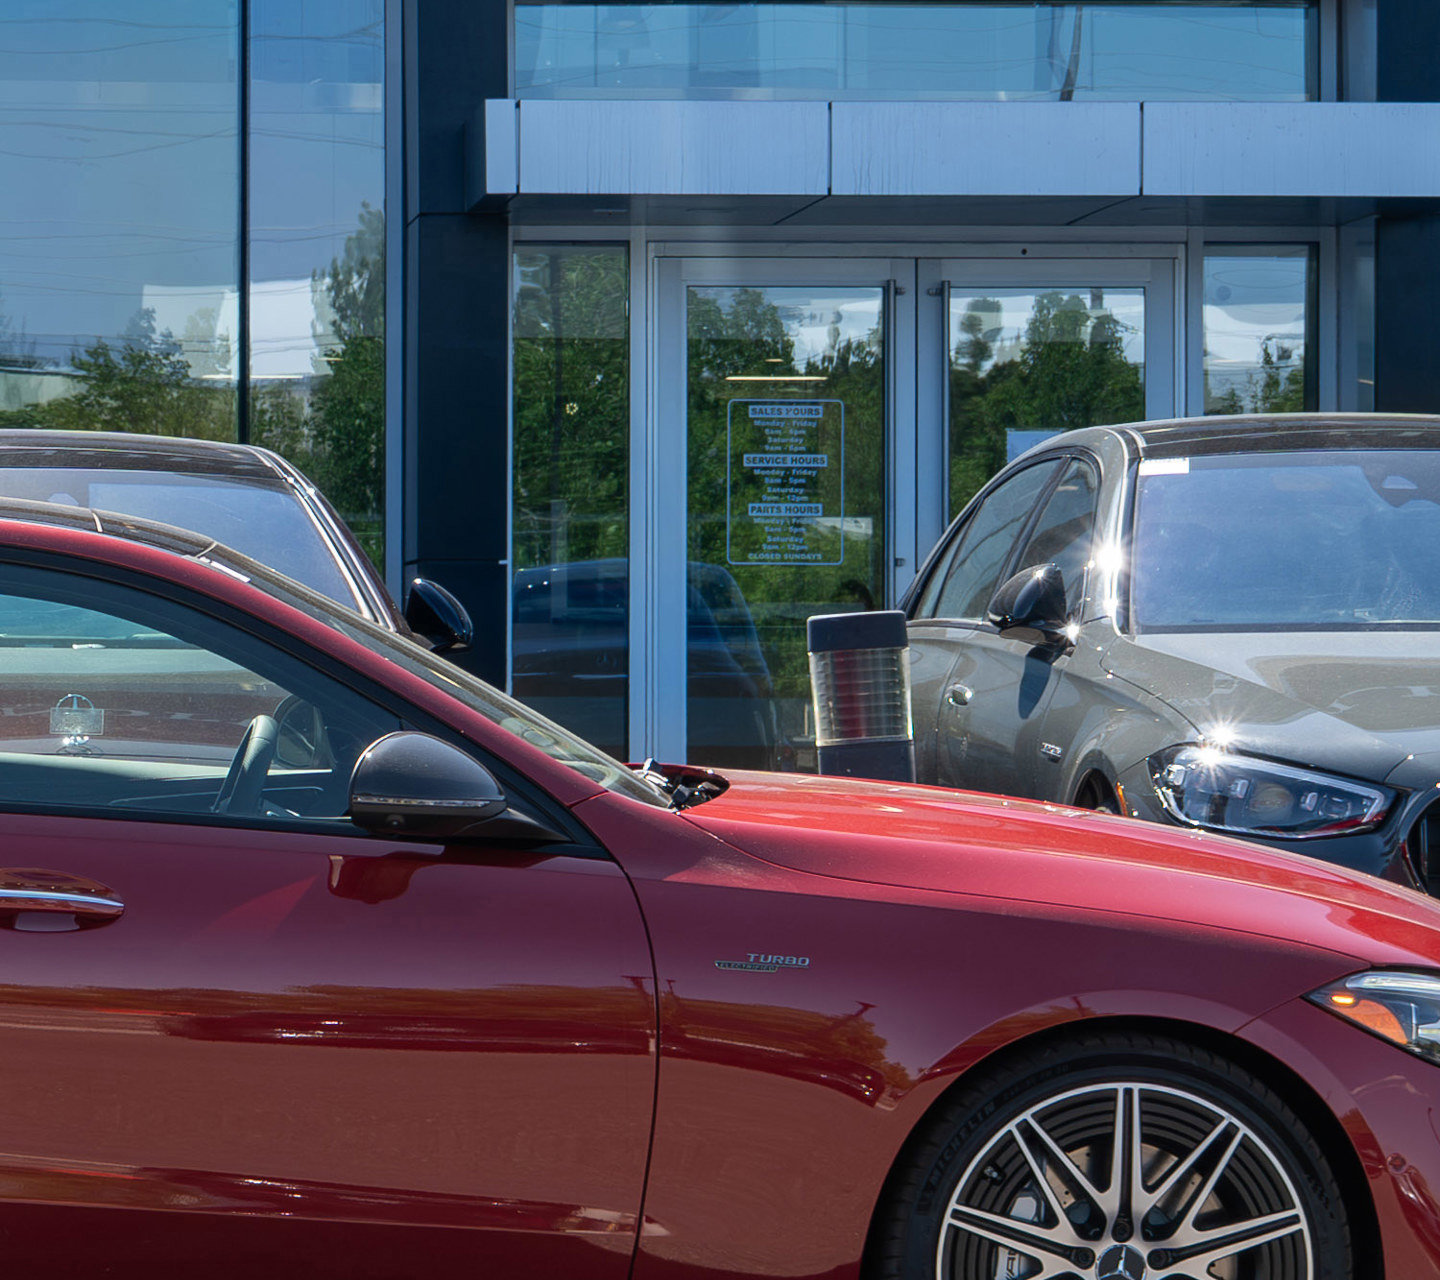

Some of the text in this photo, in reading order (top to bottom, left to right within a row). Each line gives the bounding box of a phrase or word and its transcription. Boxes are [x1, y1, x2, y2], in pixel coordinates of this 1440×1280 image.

[750, 407, 782, 416] SALES
[745, 456, 826, 465] SERVICE HOURS
[767, 486, 804, 495] Saturday
[750, 506, 821, 514] PARTS HOURS
[746, 953, 810, 967] TURBO
